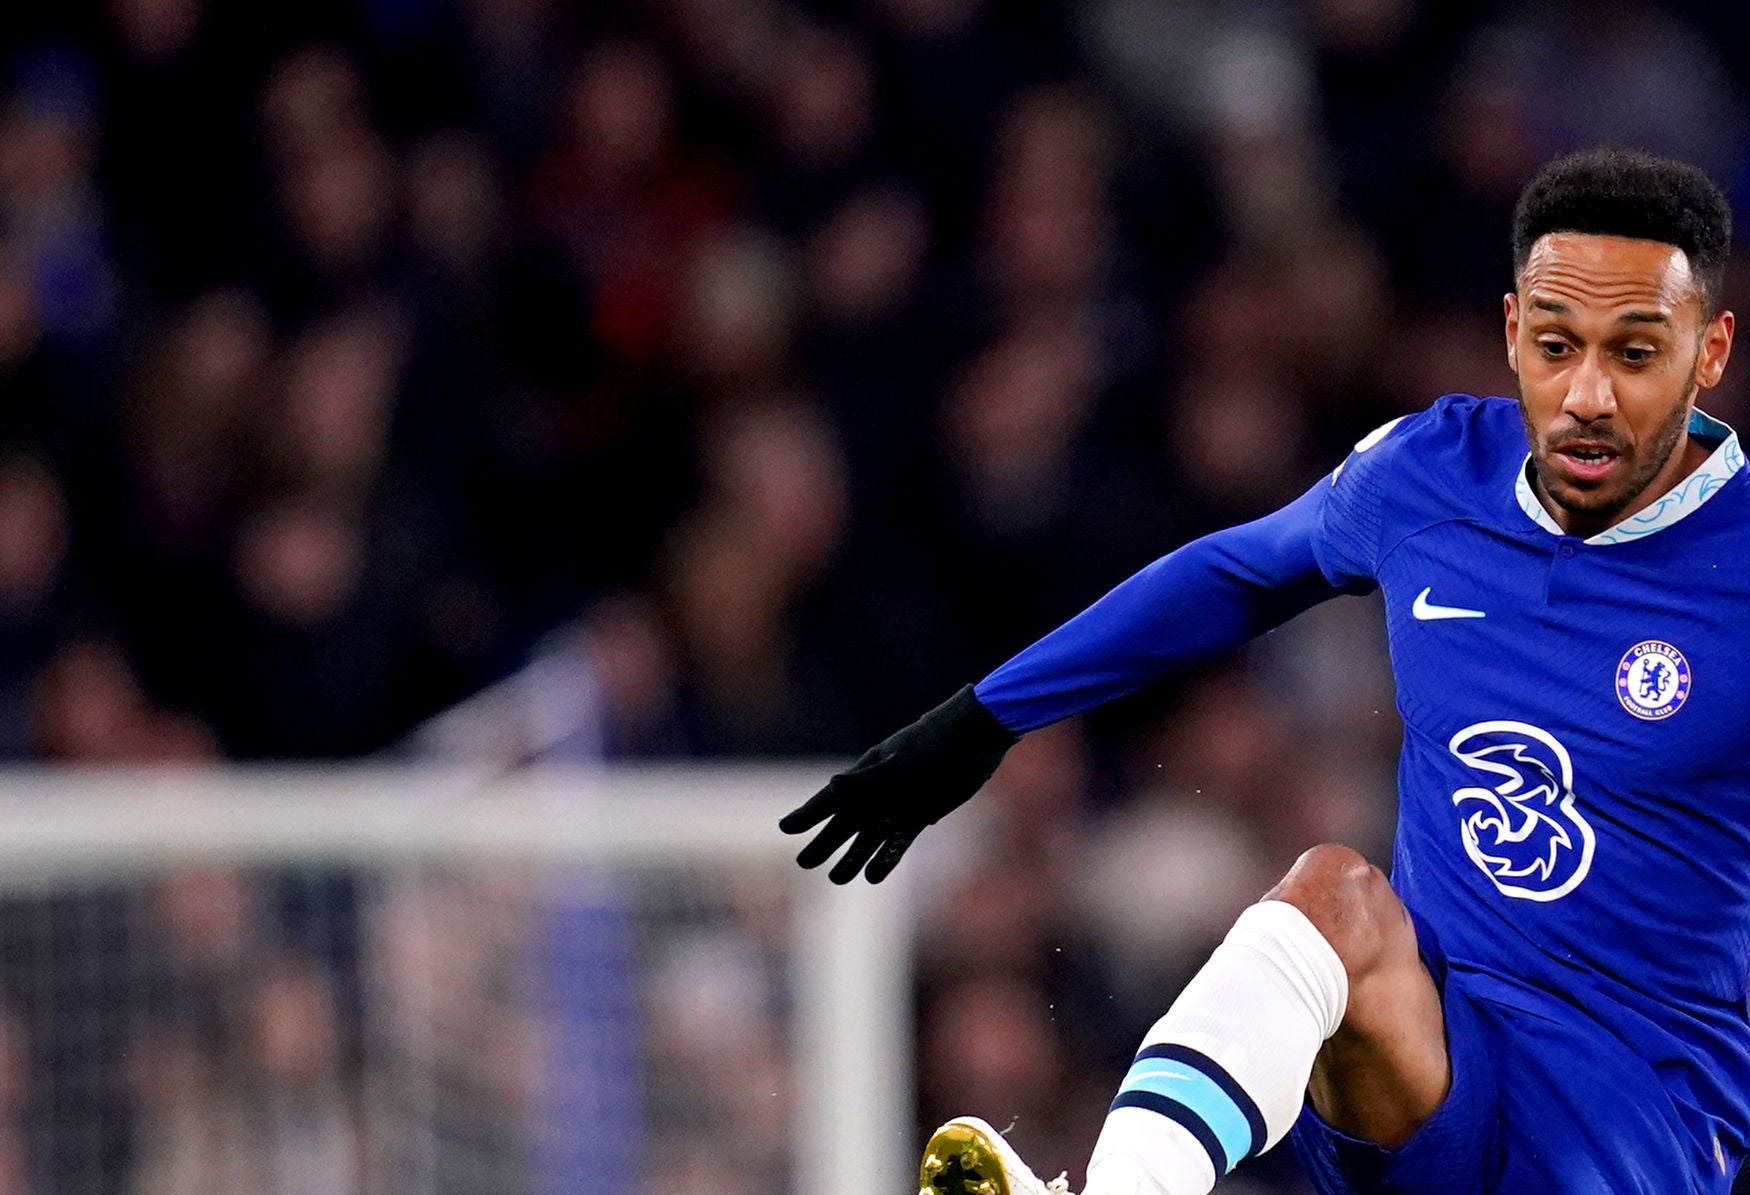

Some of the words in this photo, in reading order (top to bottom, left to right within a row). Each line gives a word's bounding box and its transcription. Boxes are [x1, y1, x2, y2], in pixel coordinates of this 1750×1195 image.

[1634, 643, 1682, 666] CHELSEA
[1624, 695, 1653, 717] FOOTBALL
[1654, 705, 1673, 716] CLUB
